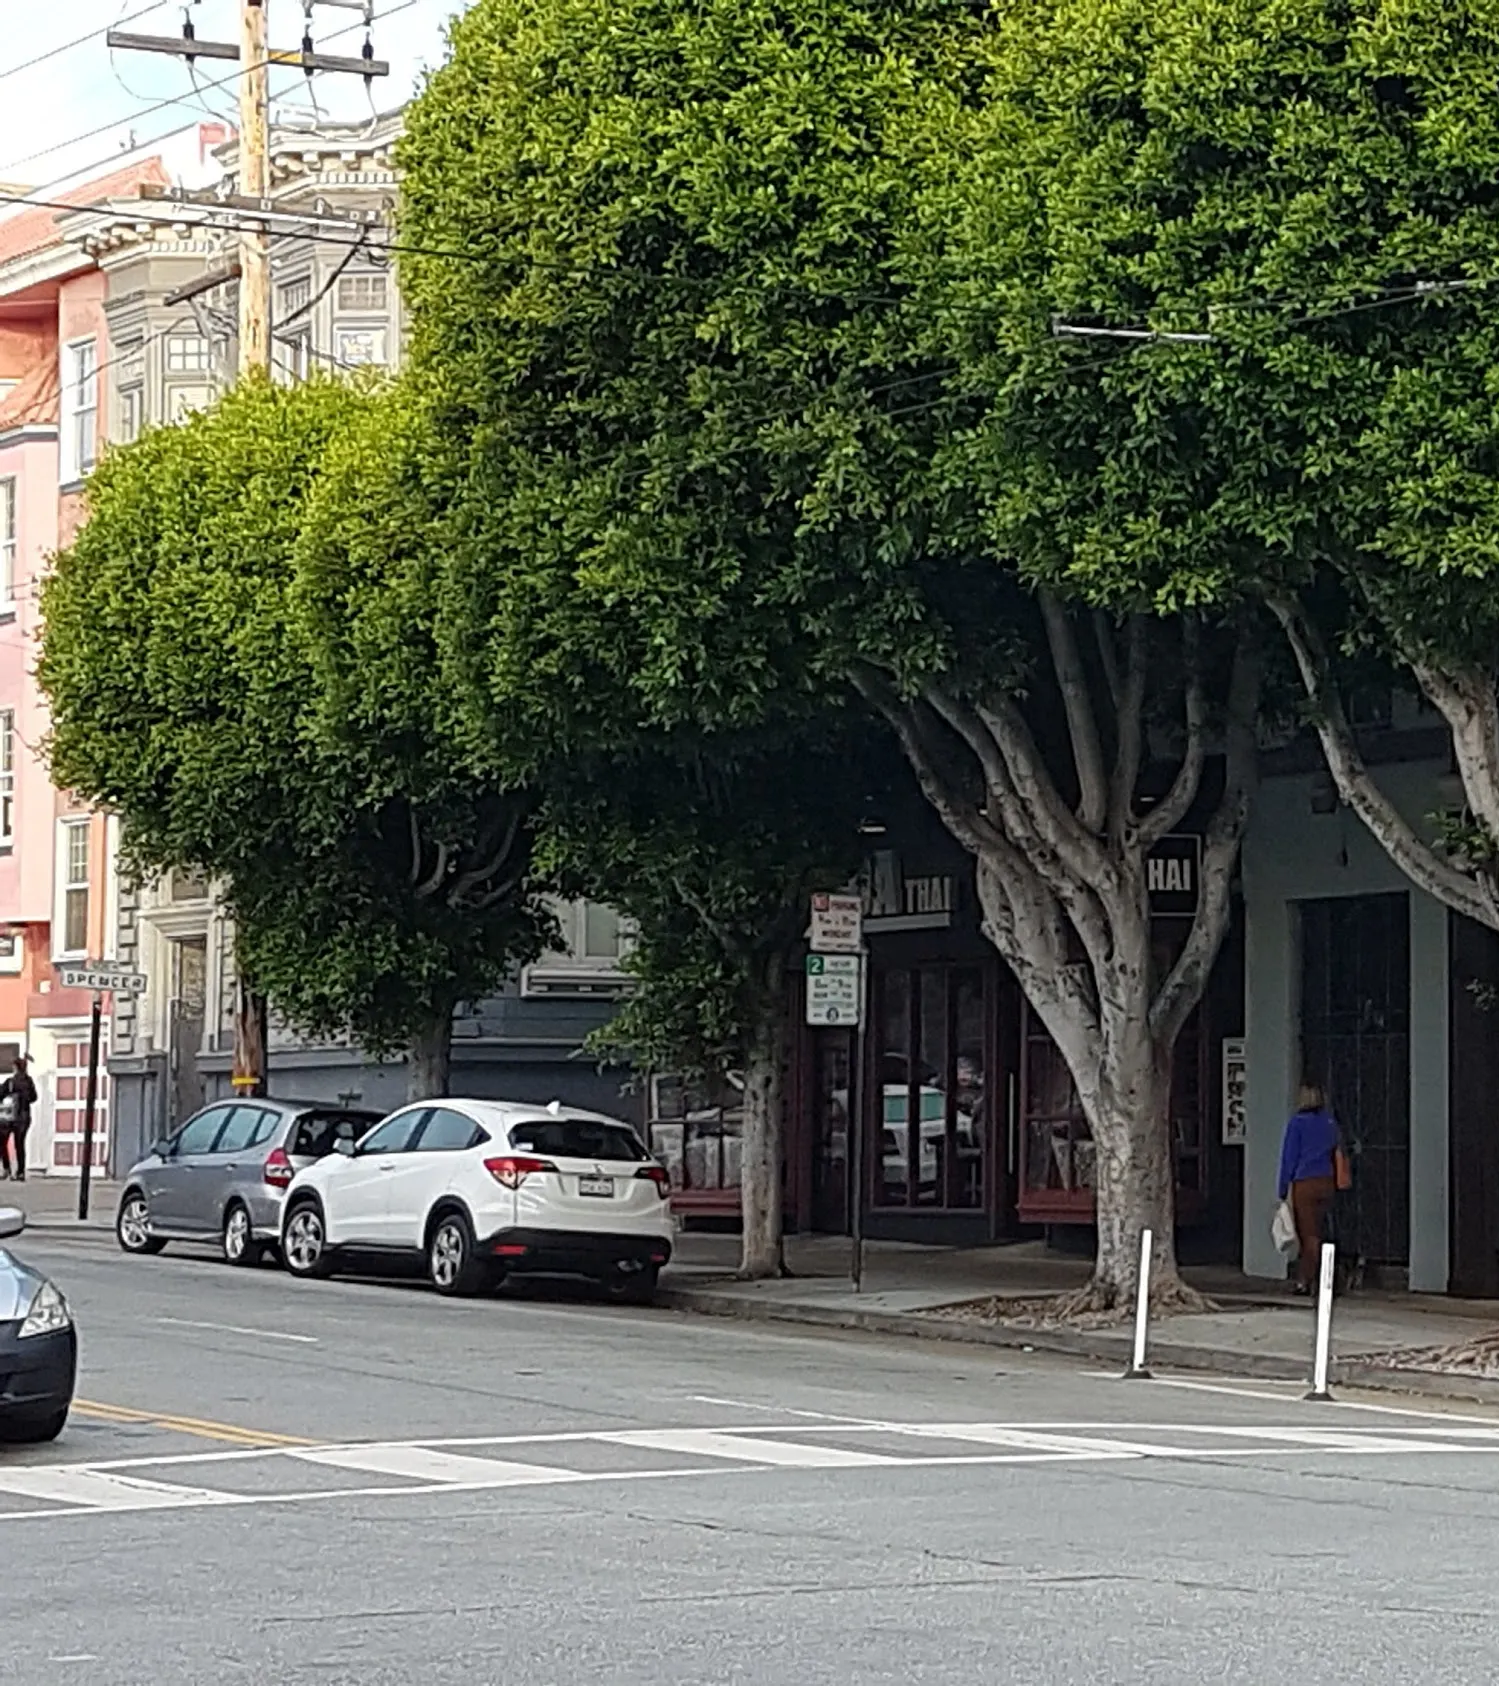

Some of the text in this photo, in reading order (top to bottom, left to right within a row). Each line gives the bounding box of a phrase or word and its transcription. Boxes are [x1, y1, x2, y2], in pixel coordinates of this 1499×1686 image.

[1148, 858, 1191, 891] HAI
[904, 876, 950, 914] THAI
[811, 957, 821, 974] 2
[67, 972, 142, 988] SPENCER
